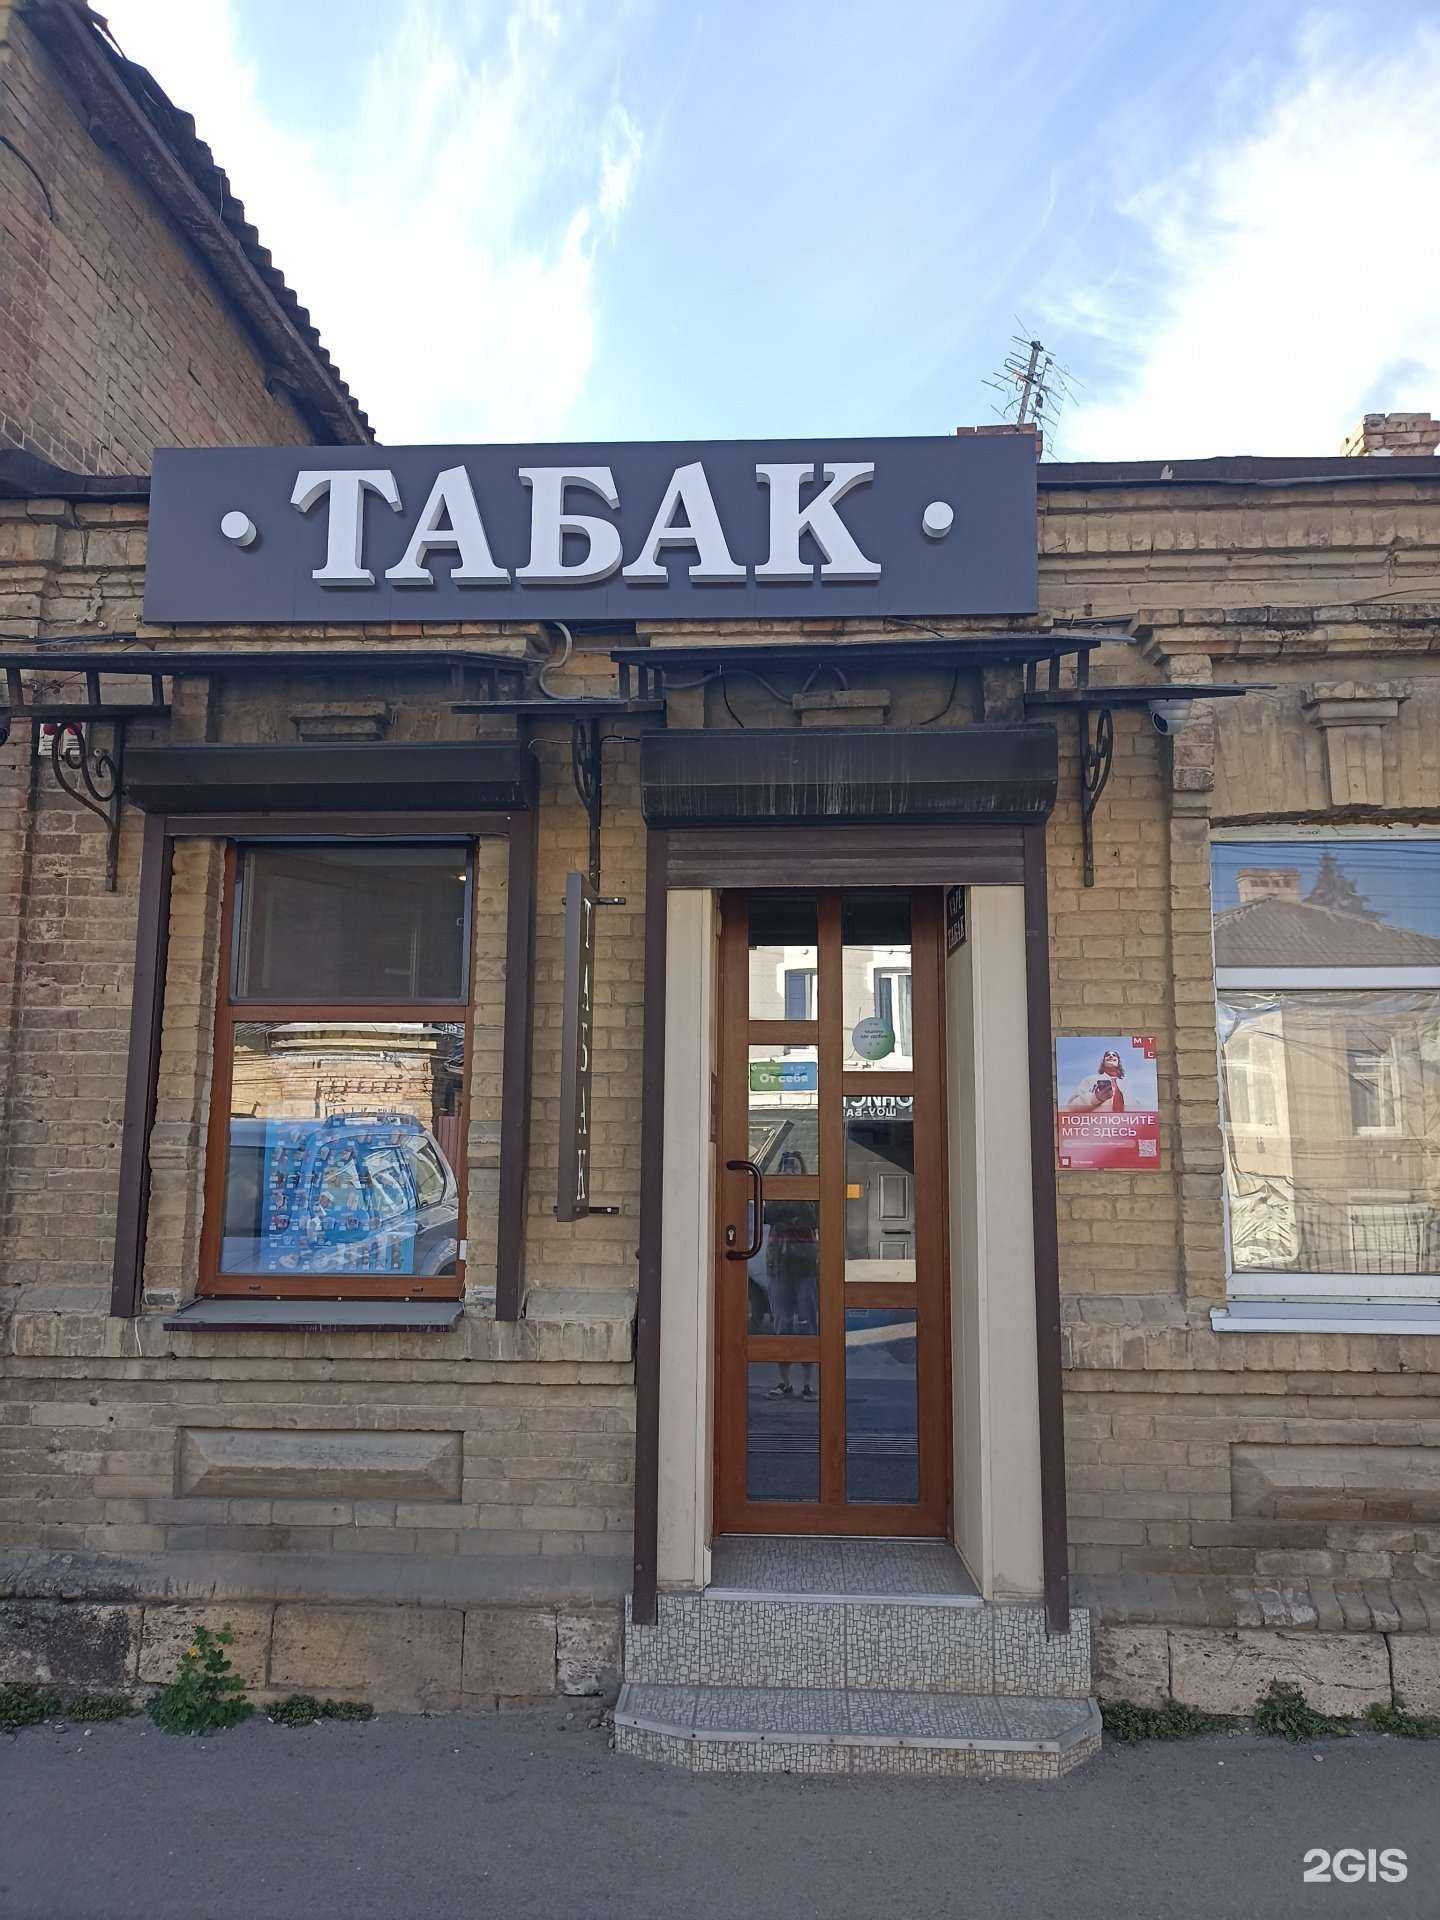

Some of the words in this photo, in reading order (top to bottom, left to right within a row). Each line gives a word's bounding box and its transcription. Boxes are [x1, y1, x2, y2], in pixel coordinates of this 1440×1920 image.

[290, 461, 881, 586] ТАБАК
[760, 1073, 775, 1083] От
[778, 1073, 809, 1084] себя
[1061, 1115, 1156, 1126] ПОДКЛЮЧИТЕ
[1062, 1127, 1090, 1136] МТС
[1093, 1127, 1137, 1138] ЗДЕСЬ
